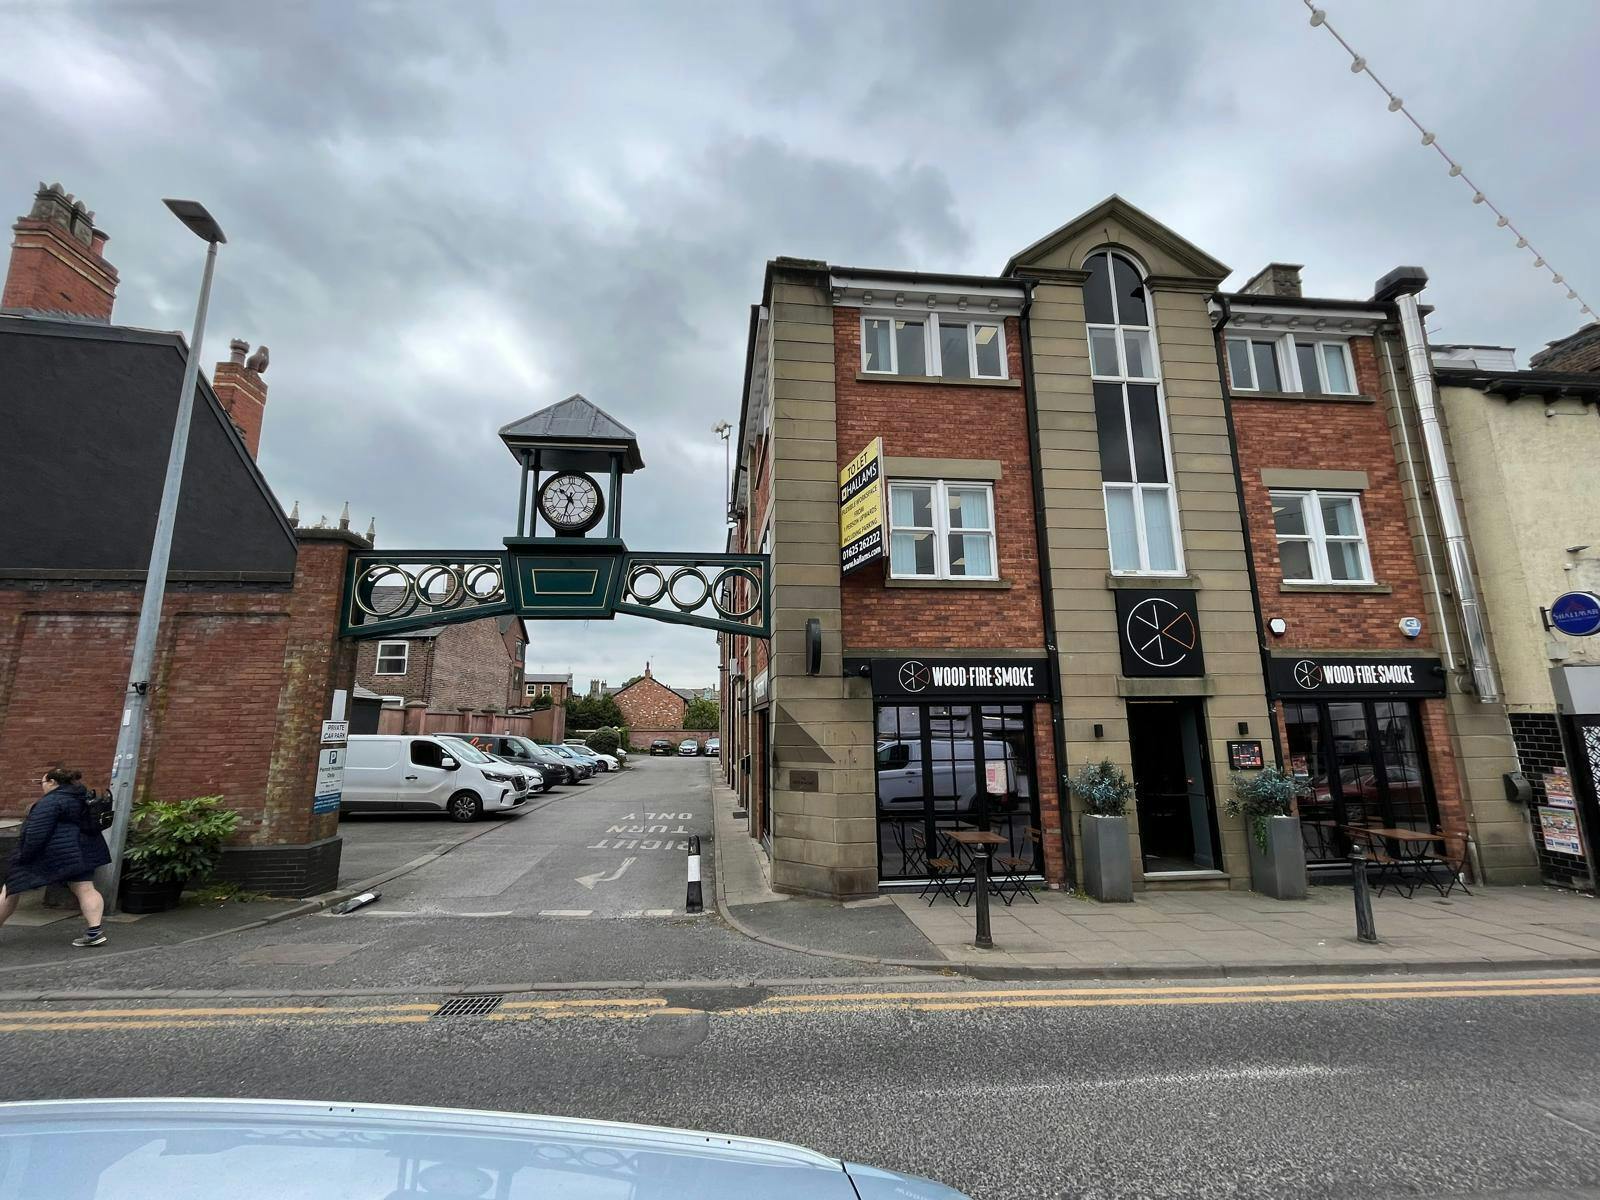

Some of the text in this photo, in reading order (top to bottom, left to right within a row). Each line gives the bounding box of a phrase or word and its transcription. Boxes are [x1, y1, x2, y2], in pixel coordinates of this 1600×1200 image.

[847, 452, 868, 479] TO LET
[846, 462, 877, 498] HALLAMS
[842, 530, 880, 561] 01625 262222
[605, 825, 689, 834] TURN
[621, 812, 692, 820] ONLY
